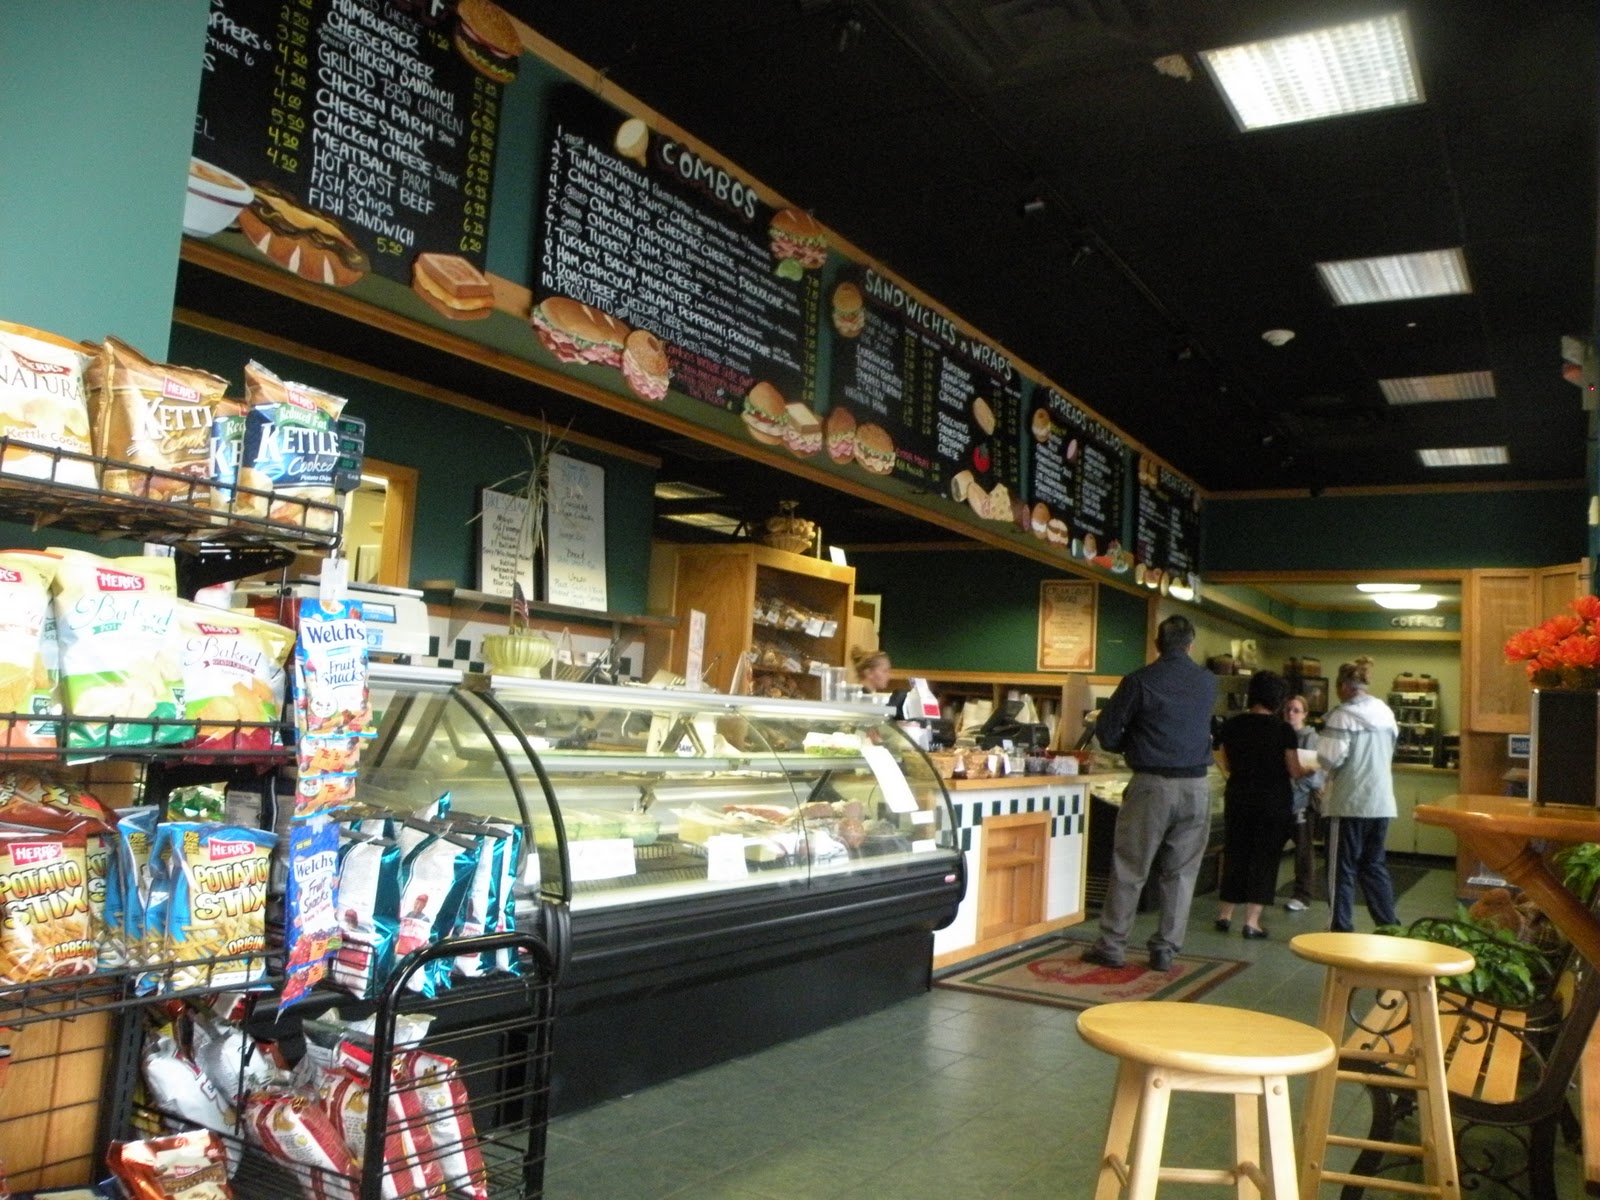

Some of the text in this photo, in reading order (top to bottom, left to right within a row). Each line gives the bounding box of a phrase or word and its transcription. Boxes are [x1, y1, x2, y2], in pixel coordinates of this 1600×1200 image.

[327, 11, 434, 82] CHEESEBURGER
[332, 0, 420, 55] HAMBURGER
[318, 43, 376, 88] GRILLED
[381, 78, 412, 107] BBQ
[417, 98, 464, 136] CHICKEN
[348, 41, 394, 78] CHICKEN
[400, 69, 455, 111] SANDWICH
[316, 88, 425, 157] CHEESE STEAK
[318, 67, 386, 114] CHICKEN
[391, 103, 434, 140] PARM
[312, 127, 431, 198] MEATBALL PARM
[313, 109, 379, 152] CHICKEN
[382, 142, 433, 177] CHEESE
[310, 166, 345, 198] FISH
[313, 146, 437, 215] HOT ROAST BEEF
[567, 148, 597, 178] TUNA
[638, 188, 668, 217] SWISS
[587, 143, 649, 191] MOZZARELLA
[662, 143, 758, 219] COMBOS
[308, 187, 415, 247] FISH SANDWICH
[568, 168, 614, 203] CHICKEN
[656, 218, 702, 252] CHEDDAR
[631, 250, 664, 277] SWISS
[620, 293, 660, 321] CHEDDAR
[865, 268, 957, 346] SANDWICHES
[970, 341, 1012, 381] WRAPS
[279, 406, 328, 431] Reduced Fat
[1049, 388, 1088, 431] SPREADS
[5, 427, 47, 440] Kettle
[254, 421, 341, 463] KETTLE
[287, 455, 339, 476] Cooked
[184, 635, 263, 667] Baked
[305, 622, 365, 645] Welch's
[321, 669, 365, 686] Snacks
[328, 657, 356, 675] Fruit
[14, 844, 59, 861] HERR'S
[211, 843, 252, 858] HERR'S
[0, 860, 82, 903] POTATO
[192, 857, 270, 893] POTATO
[308, 876, 328, 897] Fruit
[3, 886, 89, 930] STIX
[195, 882, 267, 920] STIX
[304, 889, 330, 915] Snacks
